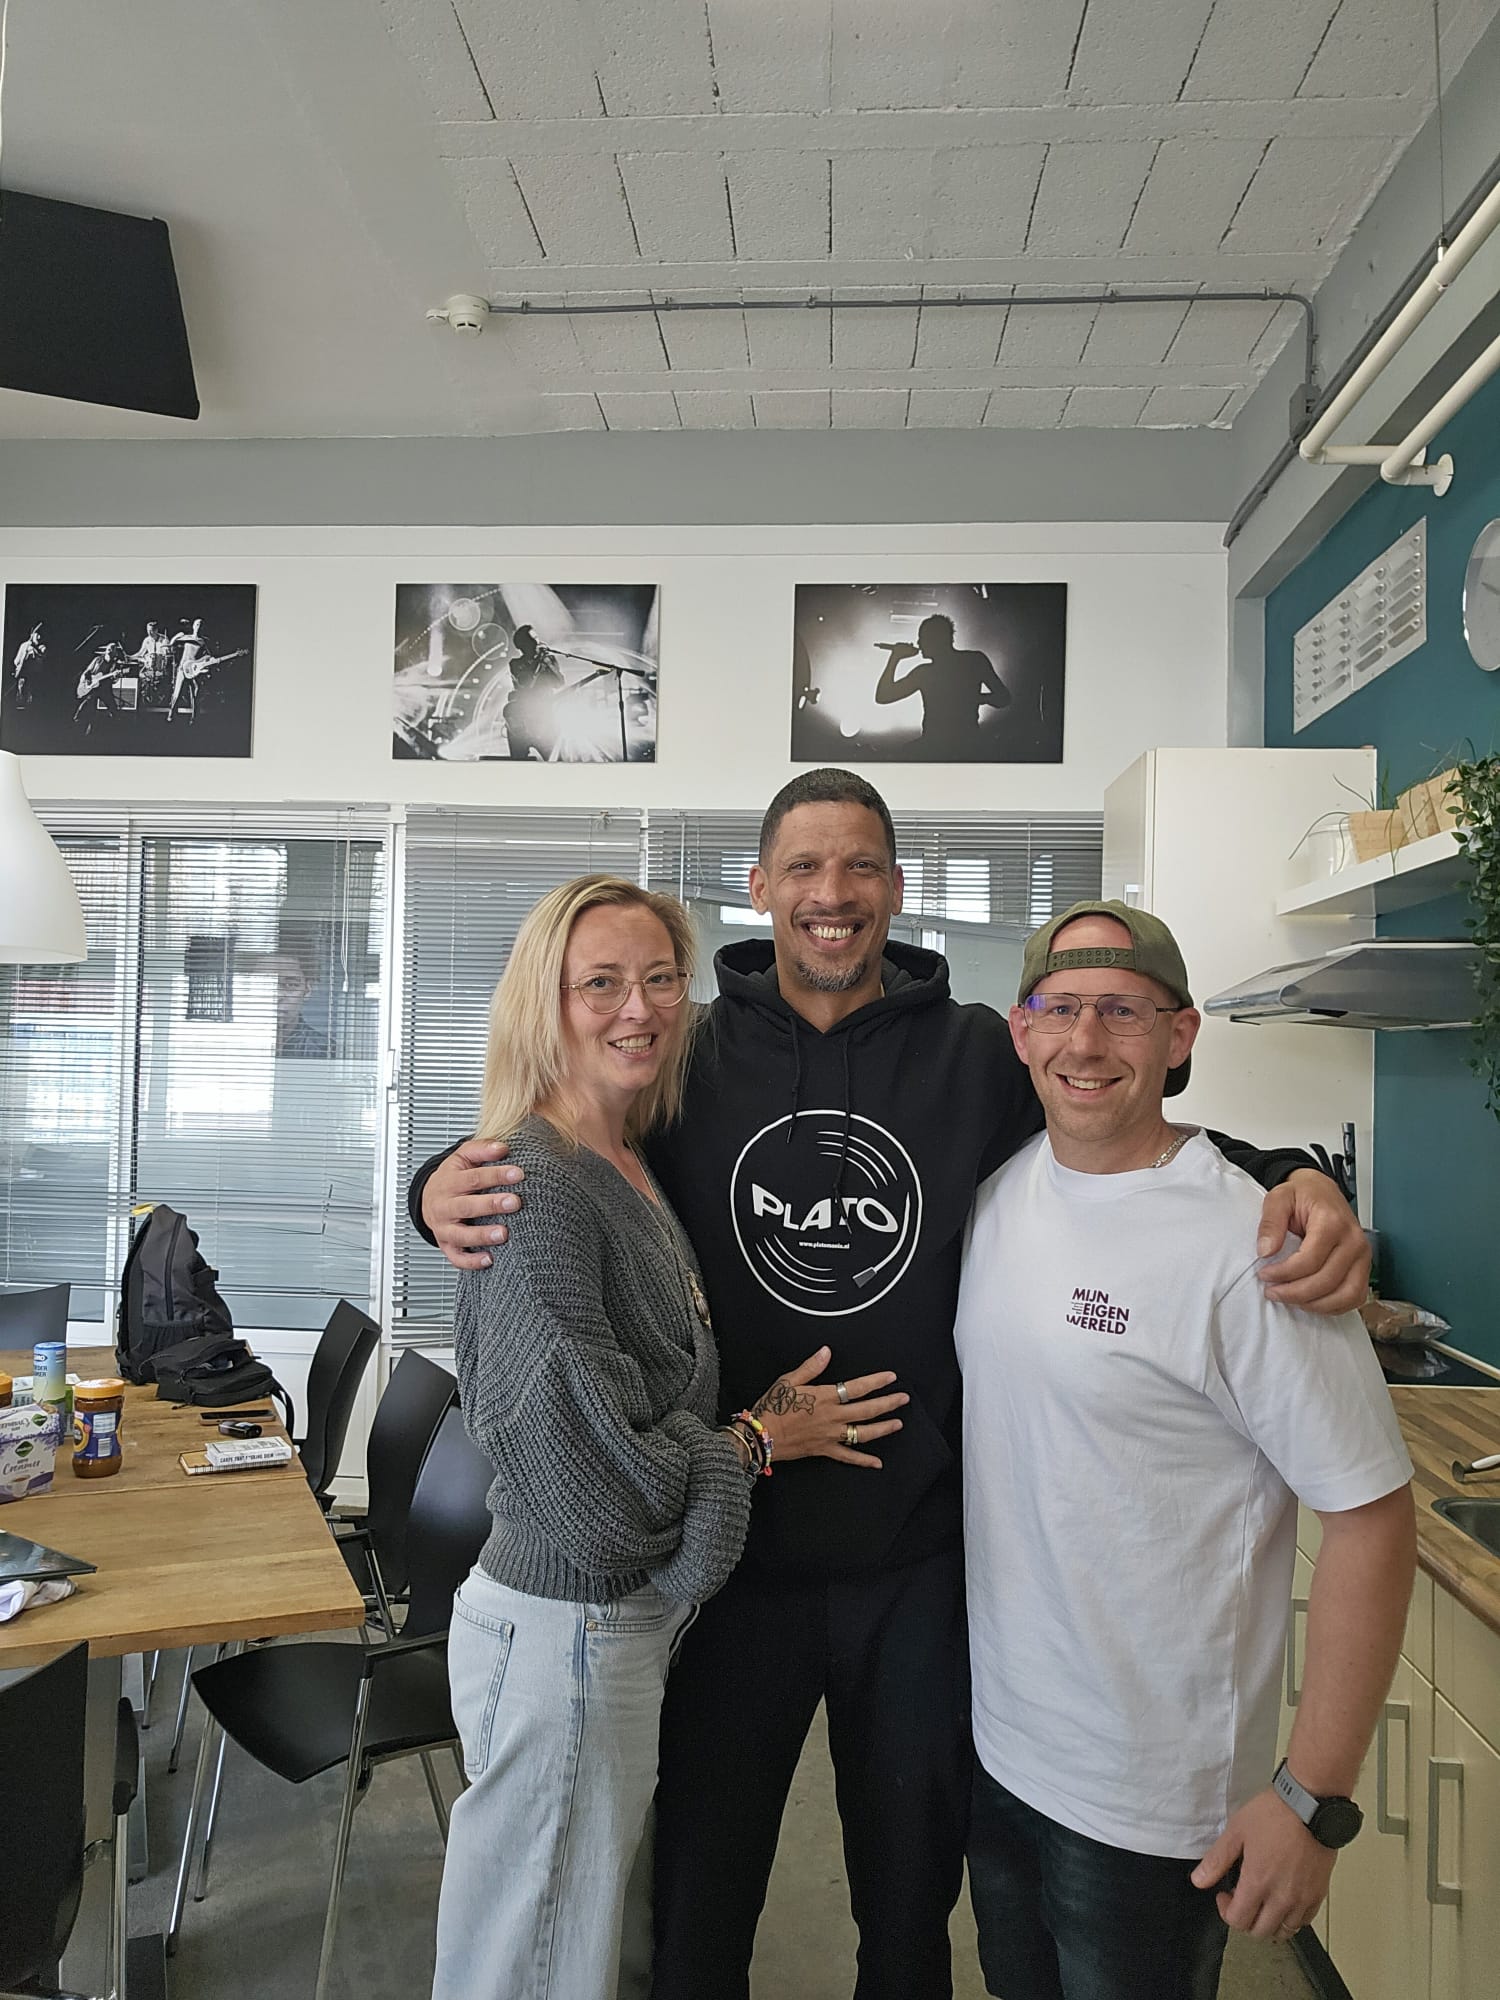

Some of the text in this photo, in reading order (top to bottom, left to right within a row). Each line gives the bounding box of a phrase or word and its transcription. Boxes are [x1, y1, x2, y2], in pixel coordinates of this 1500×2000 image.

[751, 1183, 899, 1233] PLATO
[1071, 1287, 1109, 1304] MIJN
[1083, 1302, 1130, 1322] EIGEN
[1066, 1314, 1127, 1335] WERELD
